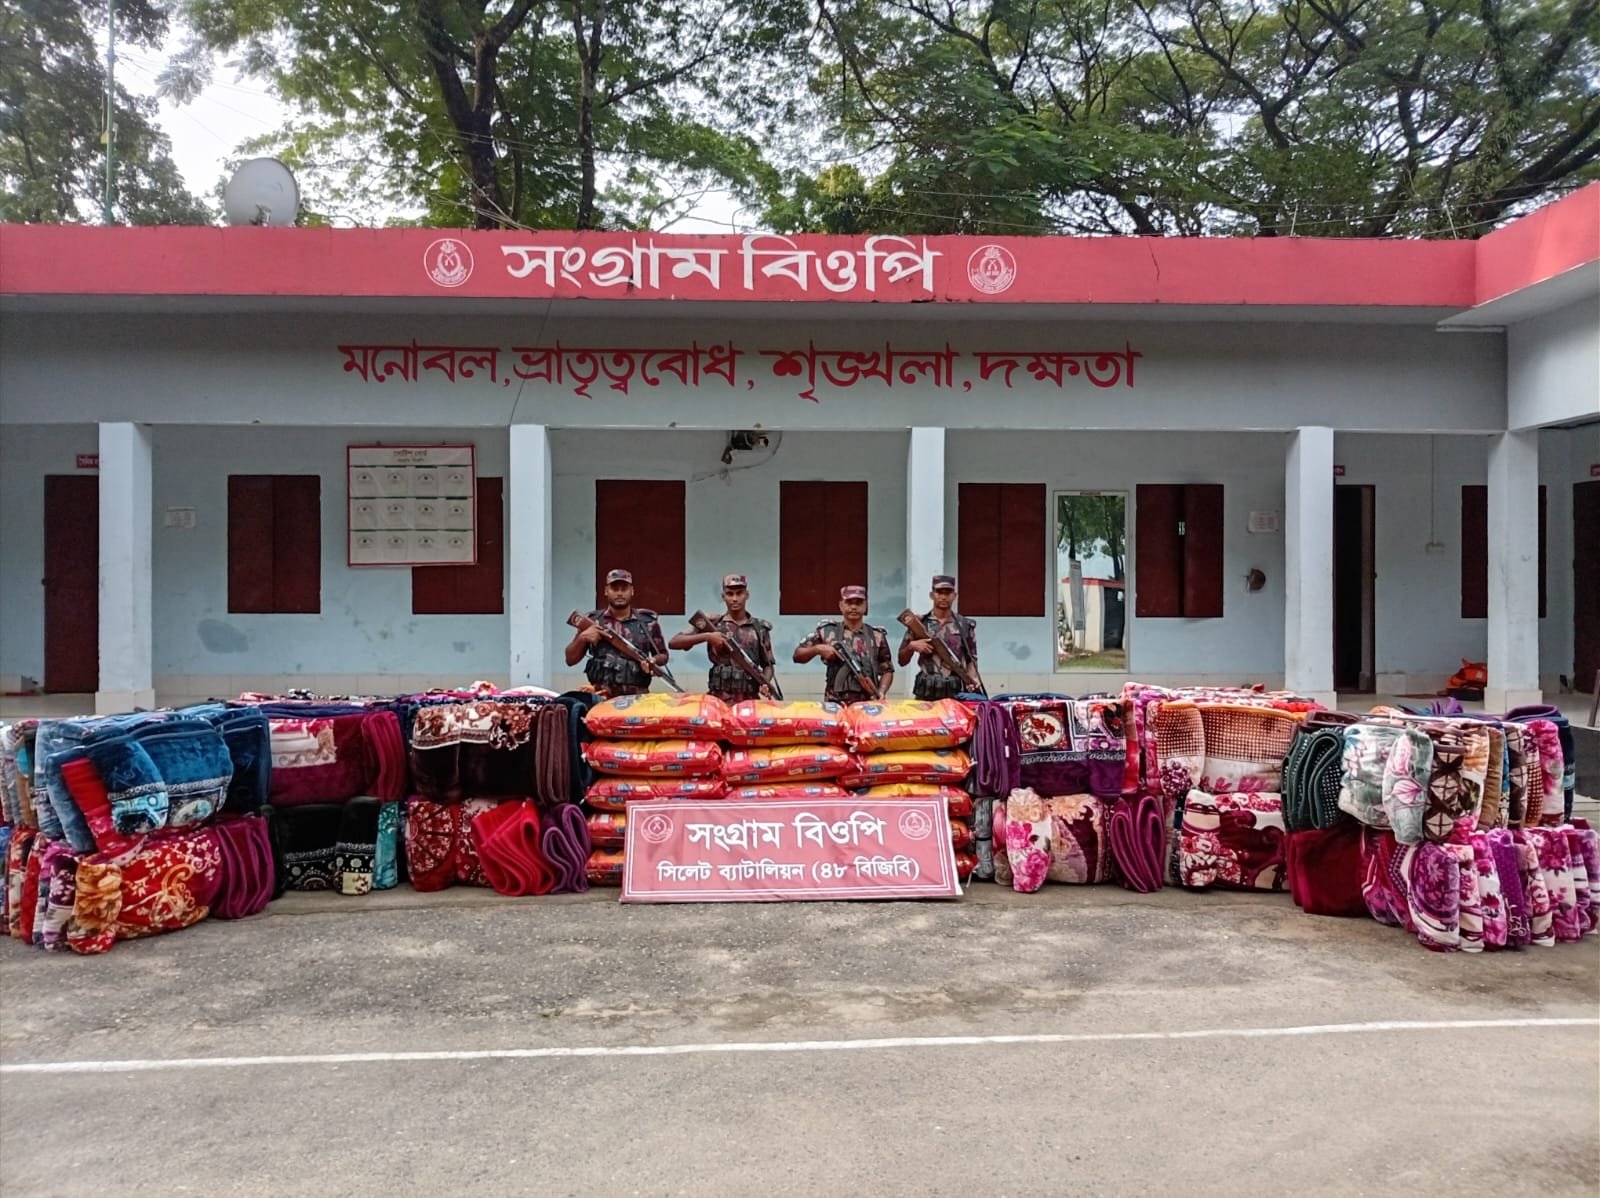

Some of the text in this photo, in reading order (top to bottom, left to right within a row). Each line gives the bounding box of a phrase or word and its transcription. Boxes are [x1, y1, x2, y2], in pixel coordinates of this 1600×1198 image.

[500, 238, 729, 289] সংগ্রাম
[737, 234, 944, 293] বিওপি
[337, 338, 511, 387] মনোবল,
[972, 340, 1144, 388] দক্ষতা
[685, 818, 785, 852] সংগ্রাম
[791, 811, 887, 849] বিওপি
[656, 854, 920, 883] সিলেট ব্যাটালিয়ন (৪৮ বিজিবি)
